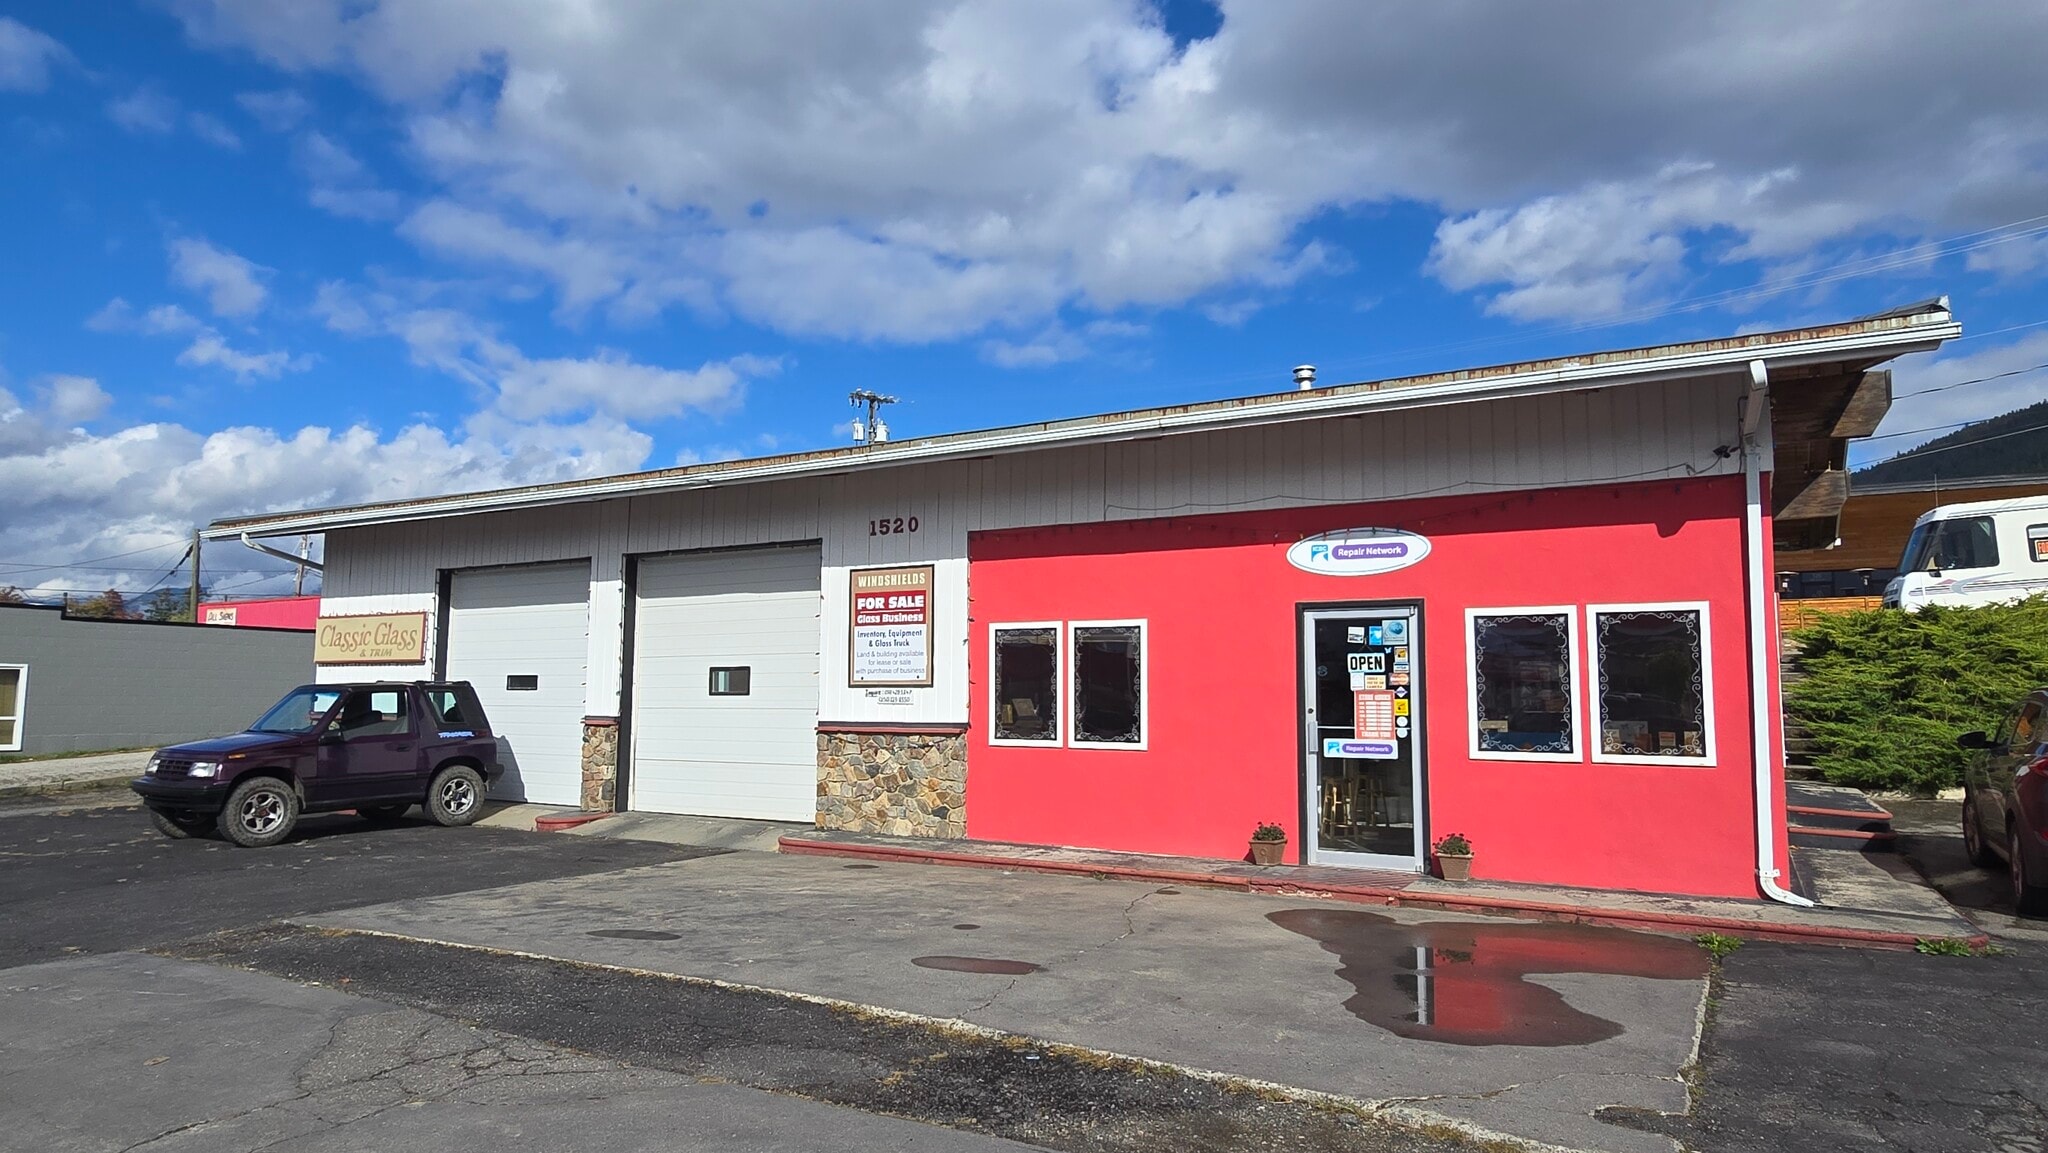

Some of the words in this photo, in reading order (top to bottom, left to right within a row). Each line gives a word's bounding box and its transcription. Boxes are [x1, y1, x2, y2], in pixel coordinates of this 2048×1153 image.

[870, 516, 919, 536] 1520
[1337, 547, 1364, 558] Repair
[1366, 546, 1402, 556] Network
[858, 573, 925, 587] WINDSHIELDS
[857, 597, 885, 610] FOR
[888, 595, 924, 609] SALE
[857, 614, 880, 624] Glass
[882, 613, 924, 622] Business
[320, 624, 371, 652] Classic
[374, 622, 417, 650] Glass
[857, 630, 886, 639] Inventory,
[888, 629, 922, 638] Equipment
[875, 639, 892, 647] Glass
[893, 638, 910, 647] Truck
[360, 649, 367, 657] &
[369, 648, 393, 657] TRIM
[876, 650, 898, 658] building
[898, 649, 924, 657] available
[1350, 656, 1383, 670] OPEN
[867, 667, 892, 675] purchase
